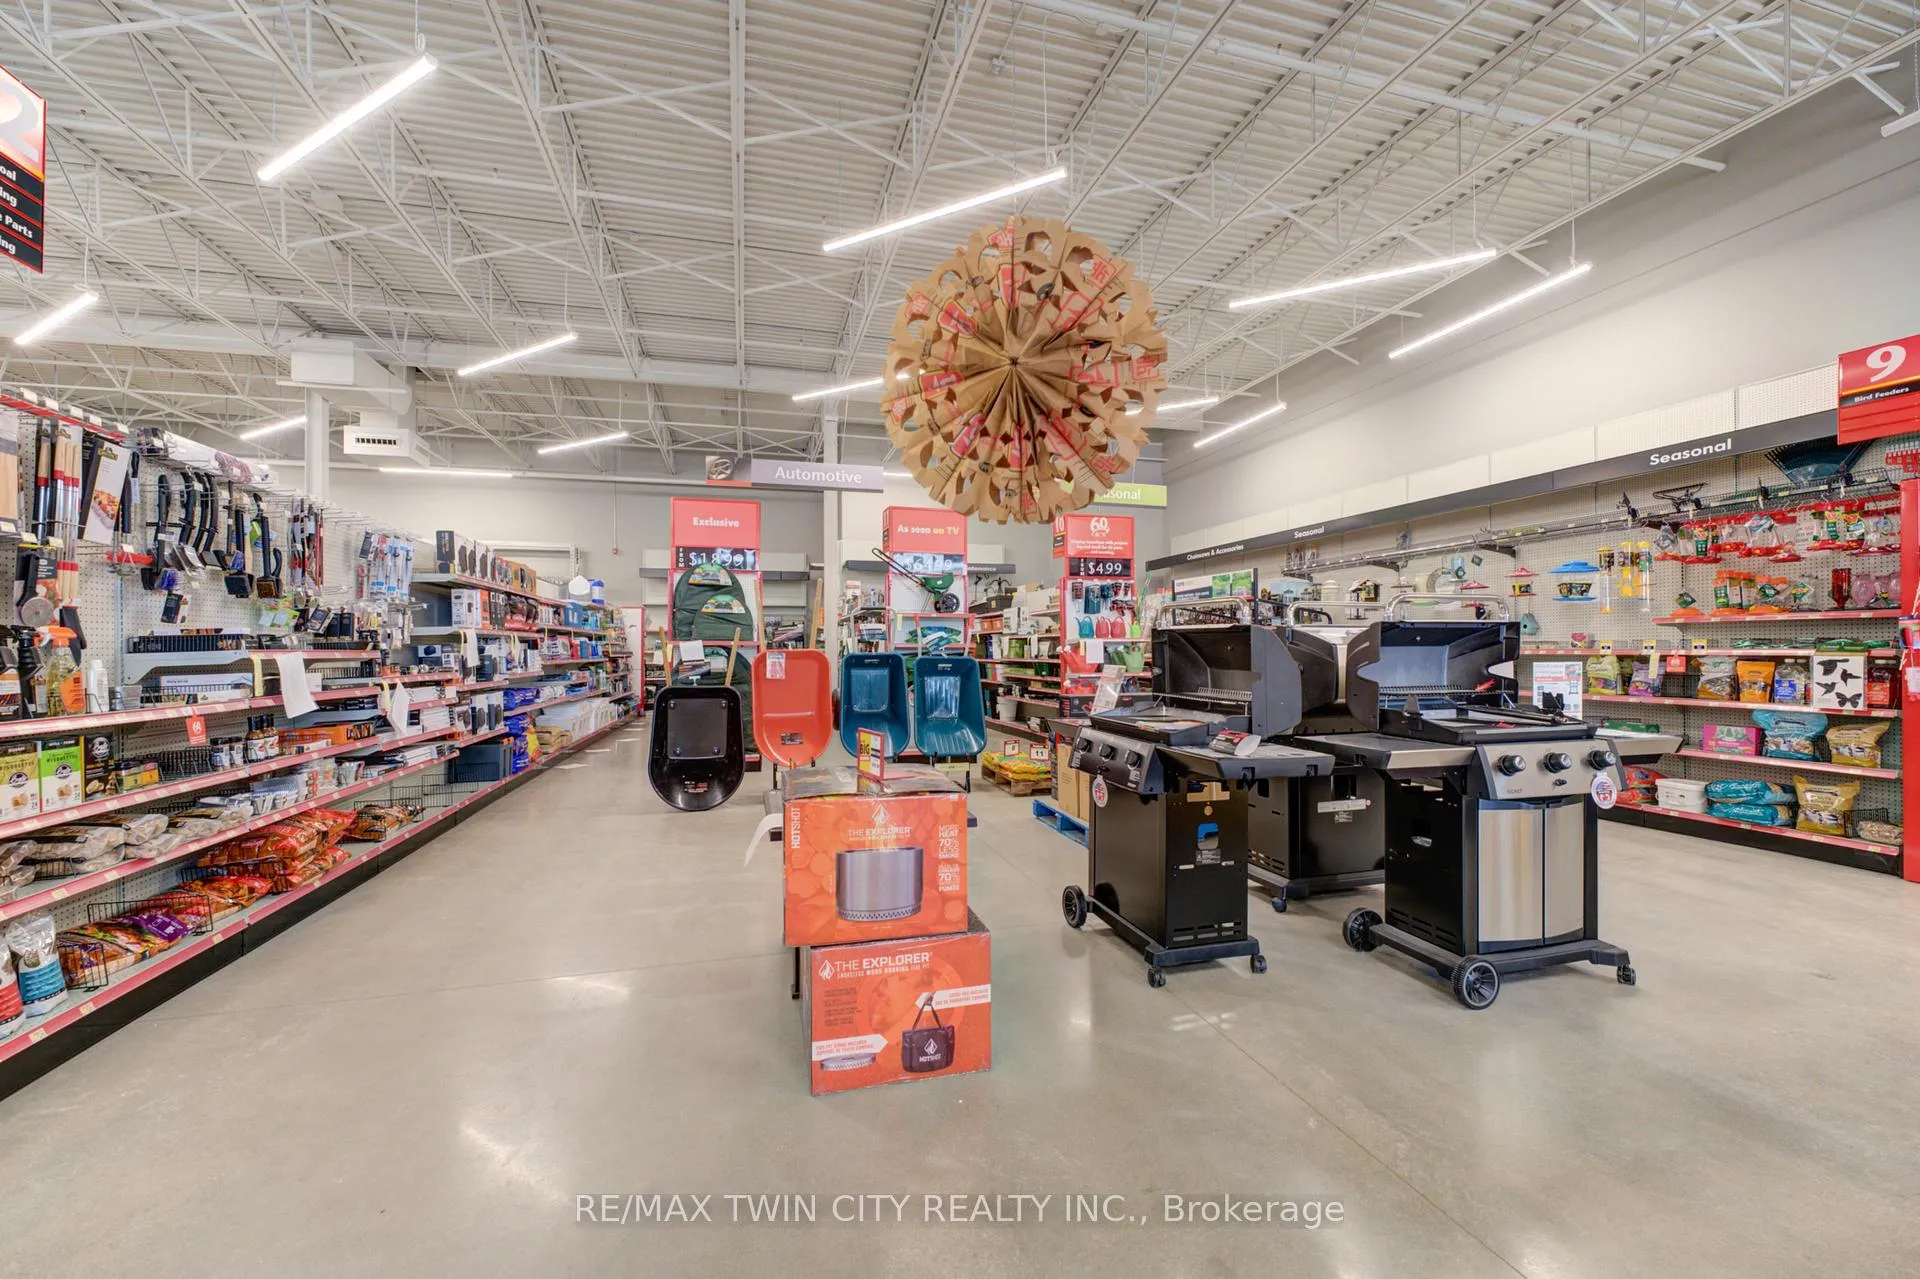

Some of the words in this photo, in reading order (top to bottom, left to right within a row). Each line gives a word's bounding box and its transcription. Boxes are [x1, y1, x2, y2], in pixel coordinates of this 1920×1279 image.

[0, 164, 16, 182] oal
[0, 188, 17, 208] ing
[5, 214, 33, 239] Parts
[1866, 345, 1906, 383] 9
[1854, 394, 1873, 402] Bird
[1875, 387, 1909, 398] Feeders
[1650, 437, 1732, 466] Seasonal
[775, 466, 862, 484] Automotive
[692, 516, 740, 527] Exclusive
[897, 525, 909, 533] As
[947, 527, 960, 535] TV
[1294, 526, 1325, 539] Seasonal
[1216, 544, 1244, 555] Accessories
[860, 744, 870, 754] BIG
[791, 807, 801, 849] HOTSHOT
[848, 829, 864, 837] THE
[865, 826, 911, 836] EXPLORER
[835, 960, 860, 972] THE
[862, 952, 930, 969] EXPLORER
[919, 1053, 941, 1063] HOTSHOT
